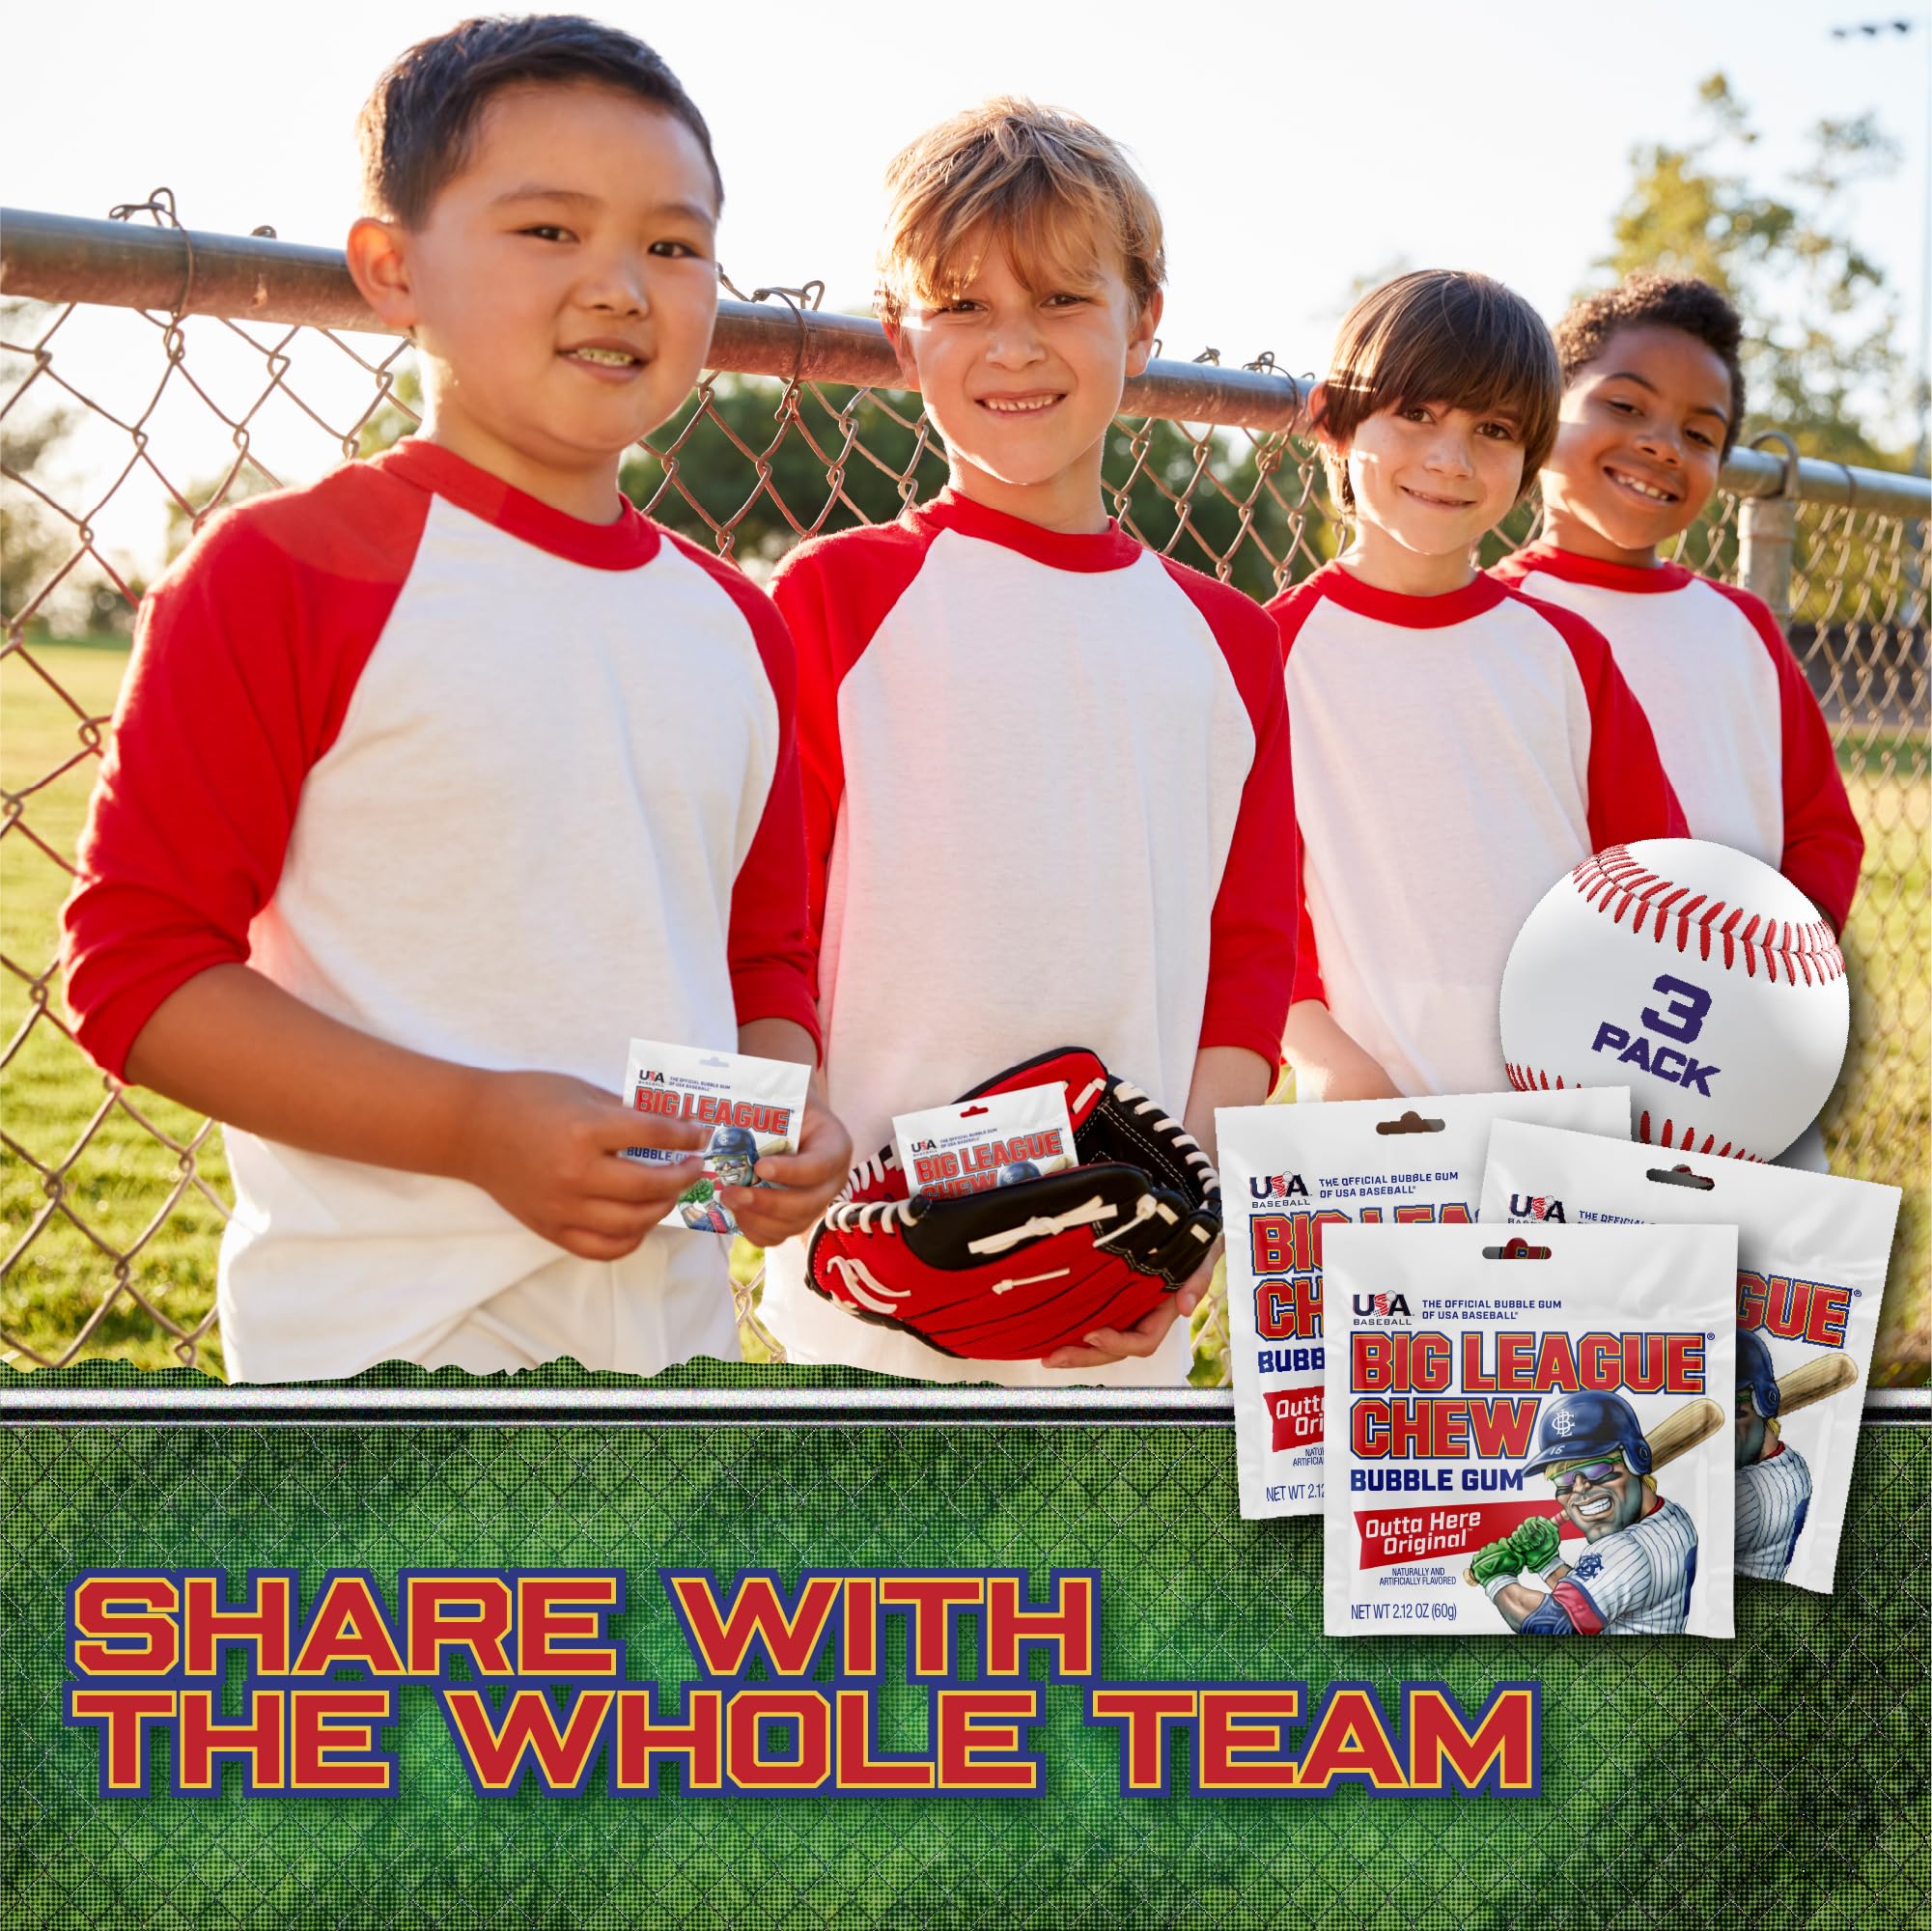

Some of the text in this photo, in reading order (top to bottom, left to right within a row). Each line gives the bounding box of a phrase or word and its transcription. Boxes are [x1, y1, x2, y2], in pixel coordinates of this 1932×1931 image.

[639, 1069, 665, 1083] USA
[633, 1085, 681, 1118] BIG
[627, 1146, 672, 1161] BUBBLE
[911, 1138, 937, 1153] USA
[913, 1151, 961, 1185] BIG
[1249, 1171, 1309, 1200] USA
[1319, 1172, 1459, 1188] THE OFFICIAL BUBBLE GUM
[1320, 1189, 1333, 1198] OF
[1336, 1188, 1357, 1197] USA
[1252, 1198, 1311, 1209] BASEBALL
[1509, 1193, 1566, 1223] USA
[1579, 1210, 1645, 1224] THE OFFICI
[1253, 1275, 1324, 1342] CH
[1353, 1292, 1412, 1317] USA
[1422, 1300, 1562, 1308] THE OFFICIAL BUBBLE GUM
[1422, 1311, 1436, 1320] OF
[1438, 1311, 1459, 1320] USA
[1258, 1348, 1325, 1373] BUBB
[1350, 1330, 1453, 1395] BIG
[1276, 1394, 1325, 1419] Outt
[1350, 1397, 1542, 1460] CHEW
[1293, 1457, 1325, 1467] ARTIFICIA
[1351, 1469, 1524, 1492] BUBBLE GUM
[1266, 1486, 1286, 1501] NET
[1288, 1485, 1305, 1500] WT
[1365, 1511, 1481, 1538] Outta Here
[1379, 1576, 1456, 1585] ARTIFICIALLY FLAVORED
[1391, 1567, 1445, 1577] NATURALLY AND
[1351, 1602, 1457, 1621] NET WT 2.12 OZ (60g)
